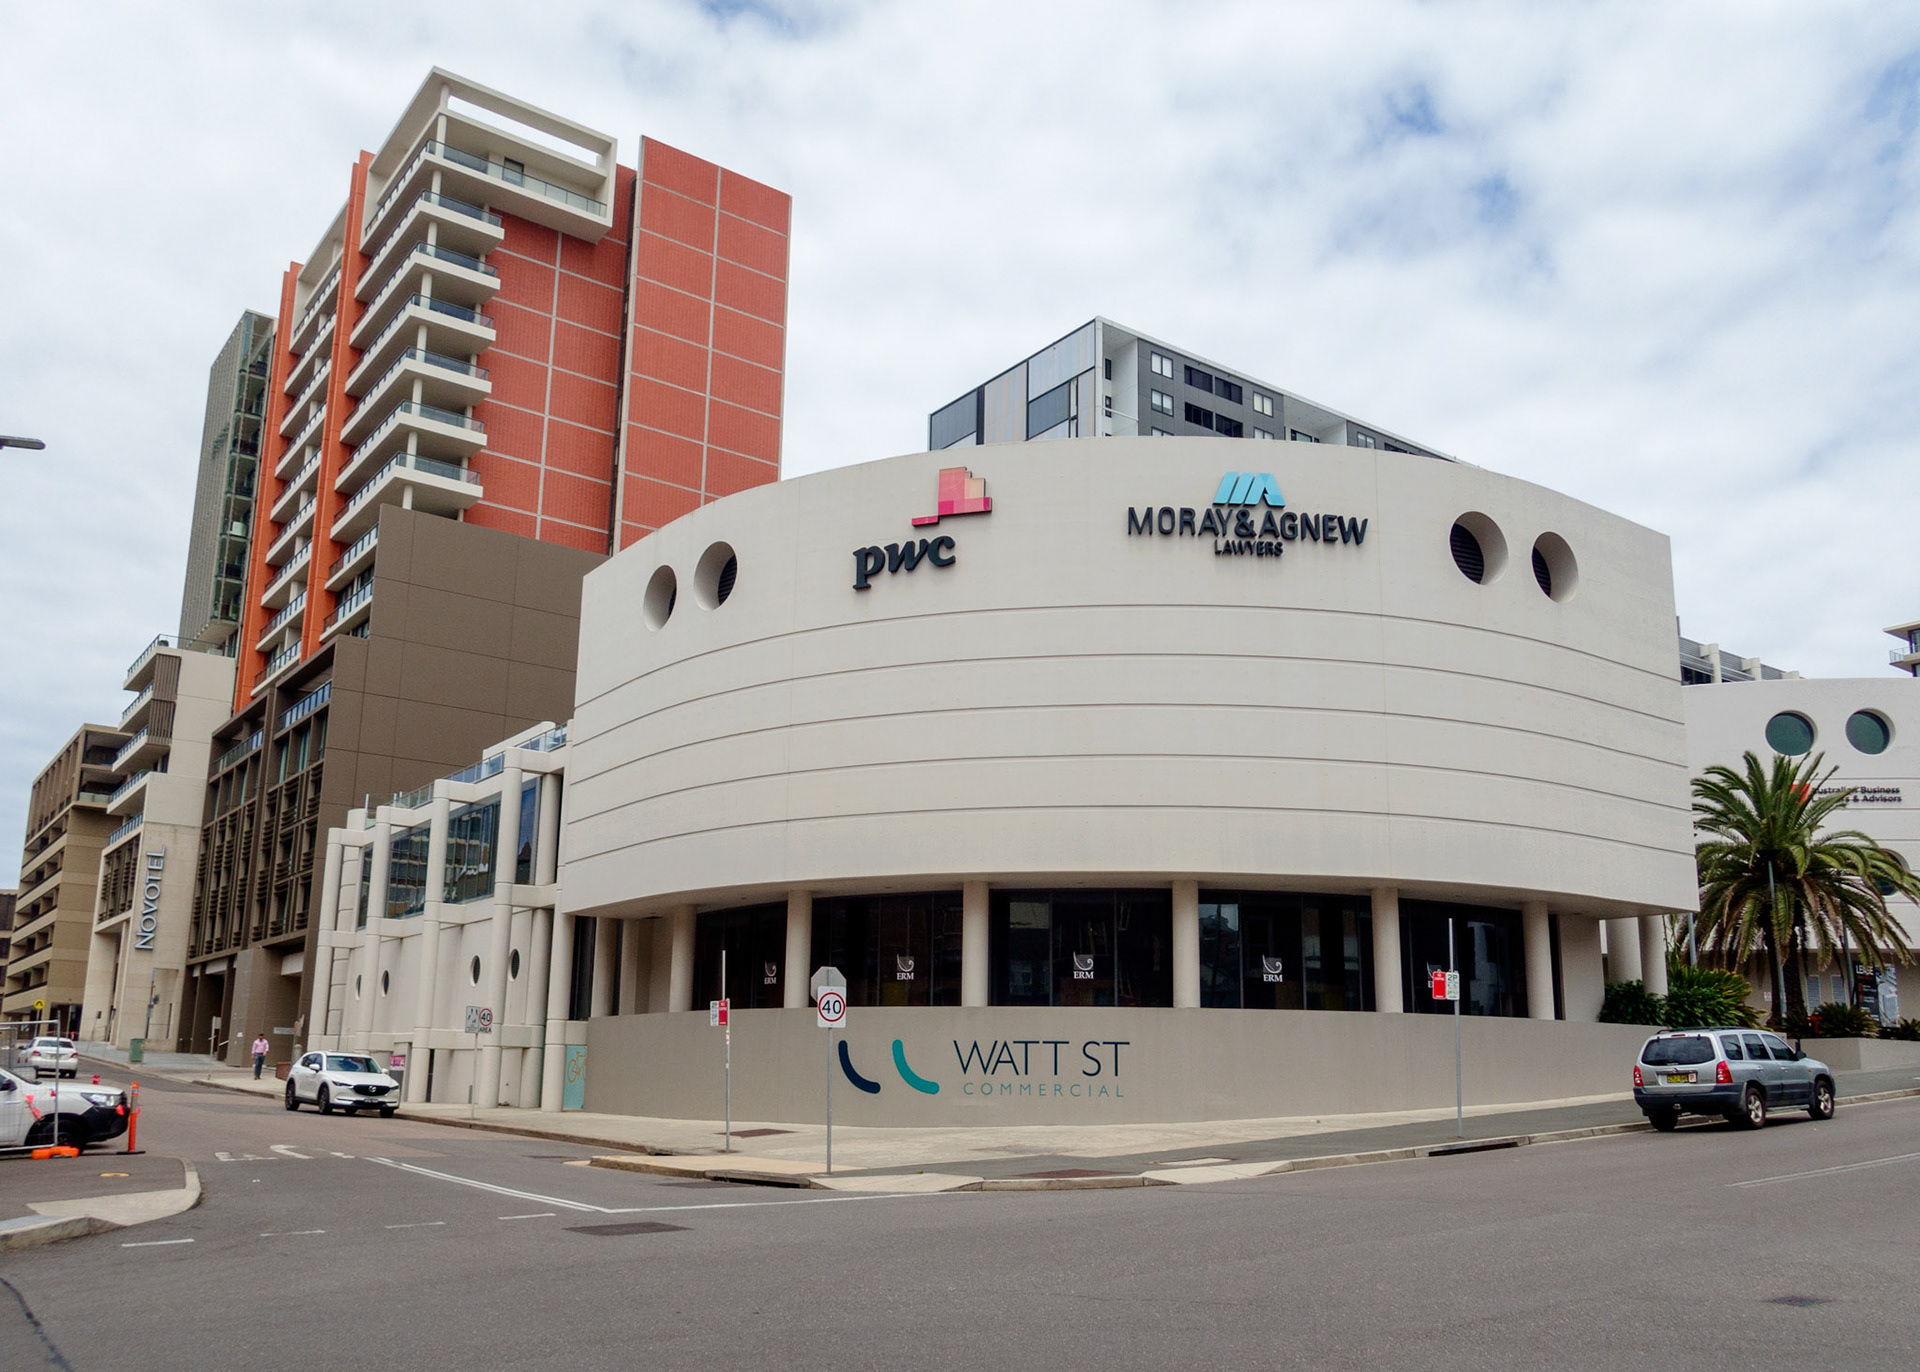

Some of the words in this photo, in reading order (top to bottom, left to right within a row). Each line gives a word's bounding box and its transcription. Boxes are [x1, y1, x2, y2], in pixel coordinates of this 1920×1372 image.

[1214, 539, 1284, 556] LAWYERS
[852, 535, 956, 590] pwc
[1861, 786, 1900, 794] Business
[1862, 795, 1902, 803] Advisors
[135, 844, 166, 950] NOVOTEL
[896, 972, 915, 981] ERM
[1073, 971, 1094, 979] ERM
[1263, 974, 1283, 982] ERM
[764, 977, 777, 985] ERM
[821, 1000, 842, 1015] 40
[481, 1012, 491, 1022] 40
[953, 1040, 1070, 1076] WATT
[1082, 1040, 1131, 1077] ST
[963, 1082, 1125, 1097] COMMERCIAL
